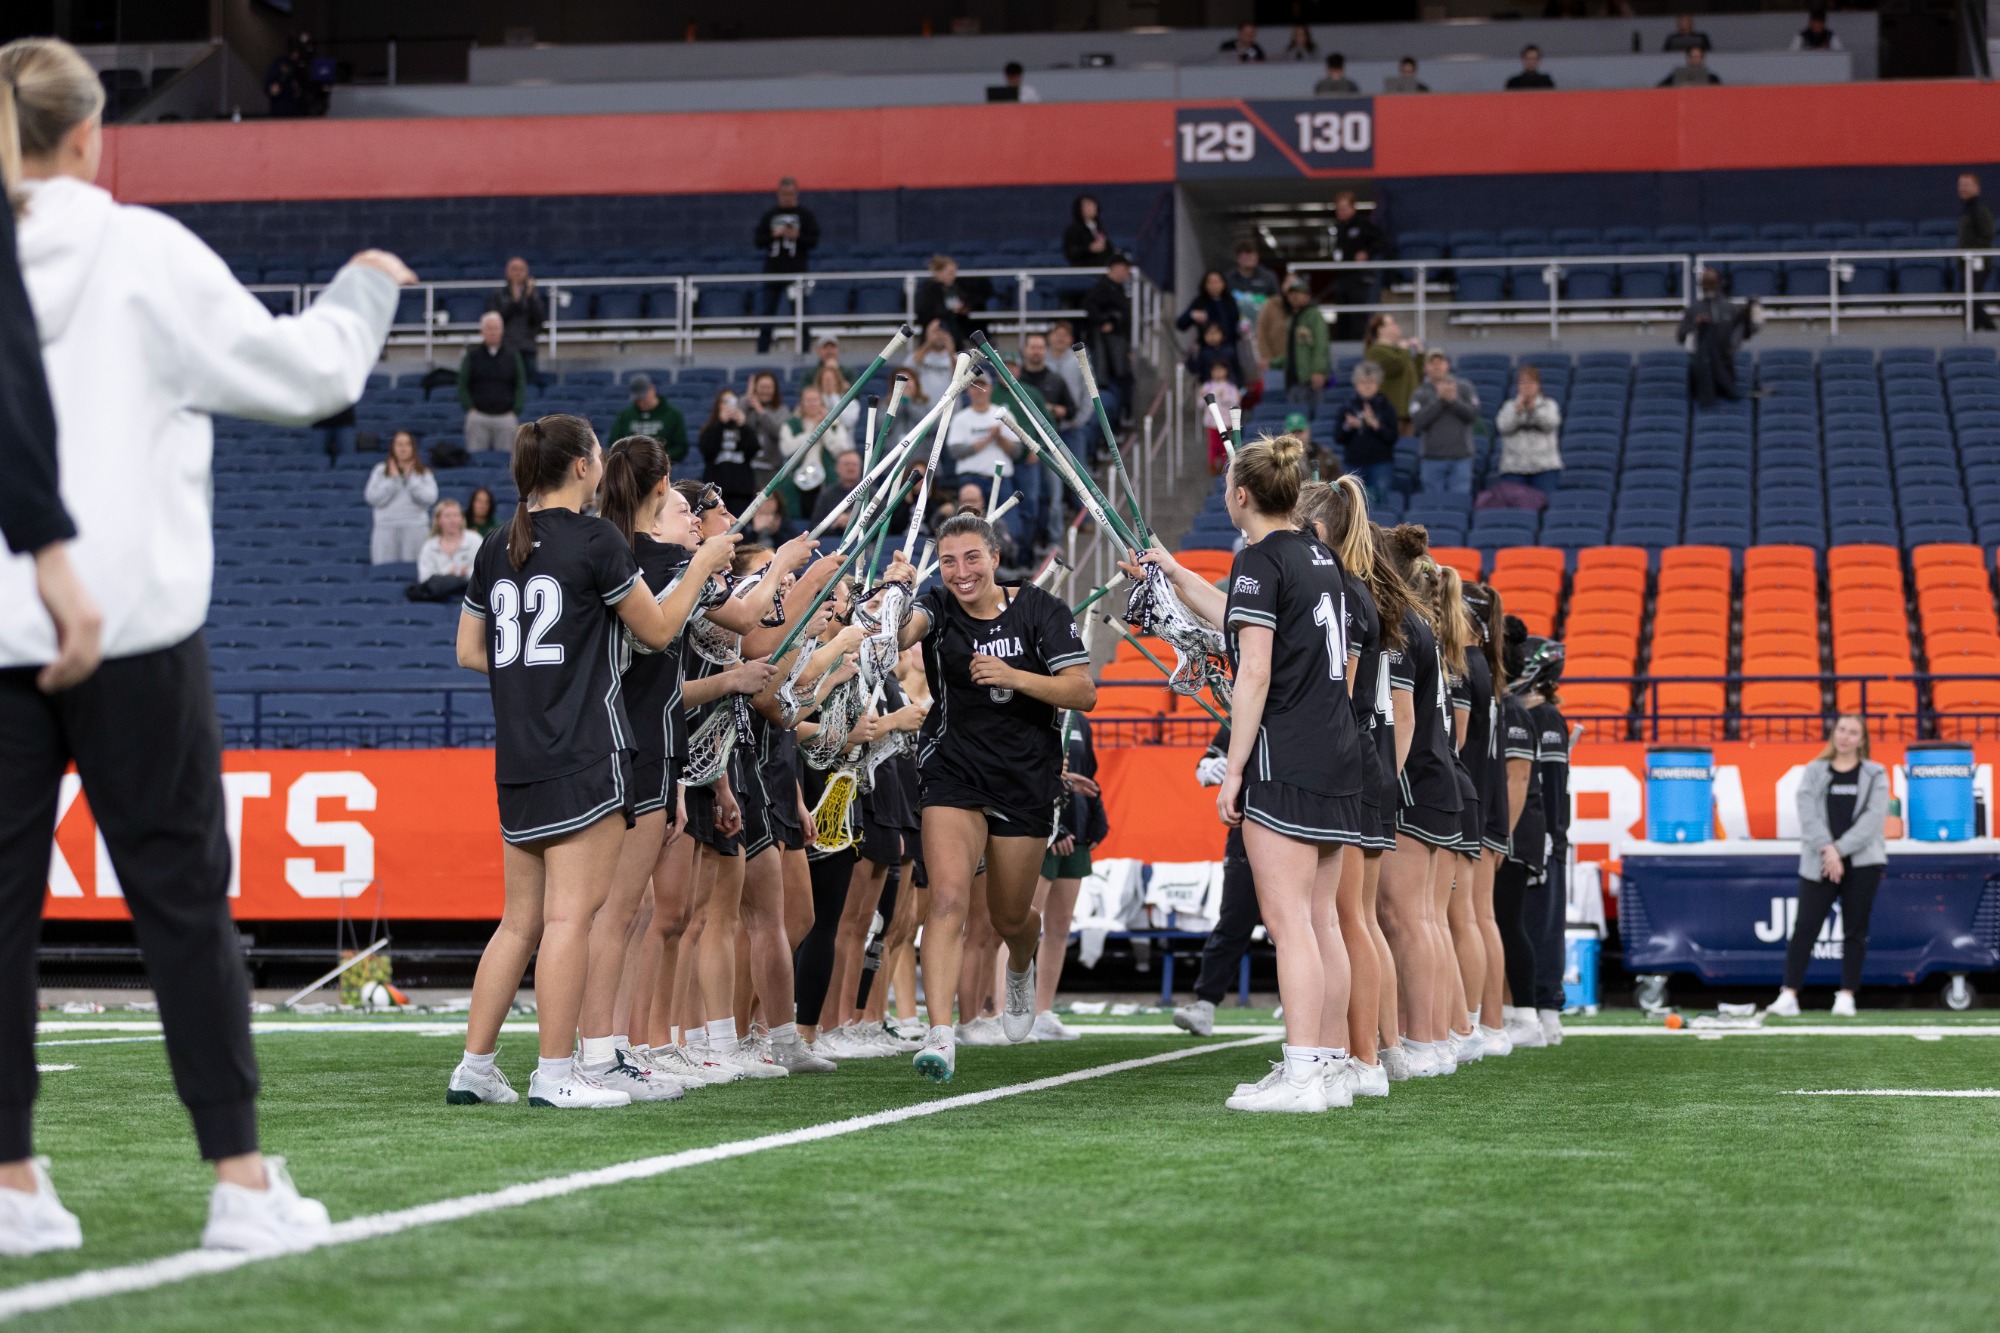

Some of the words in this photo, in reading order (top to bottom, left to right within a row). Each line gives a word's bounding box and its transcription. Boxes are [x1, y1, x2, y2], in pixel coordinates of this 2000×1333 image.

[1179, 121, 1255, 163] 129
[1295, 111, 1371, 153] 130
[846, 476, 873, 505] HOUNDS
[1090, 486, 1109, 510] GAIT
[859, 504, 878, 528] GAIT
[911, 508, 922, 530] GAIT
[1095, 507, 1110, 527] GAIT
[490, 574, 564, 668] 32
[1143, 608, 1152, 628] GAIT
[1312, 592, 1348, 681] 1
[738, 732, 746, 744] AIT
